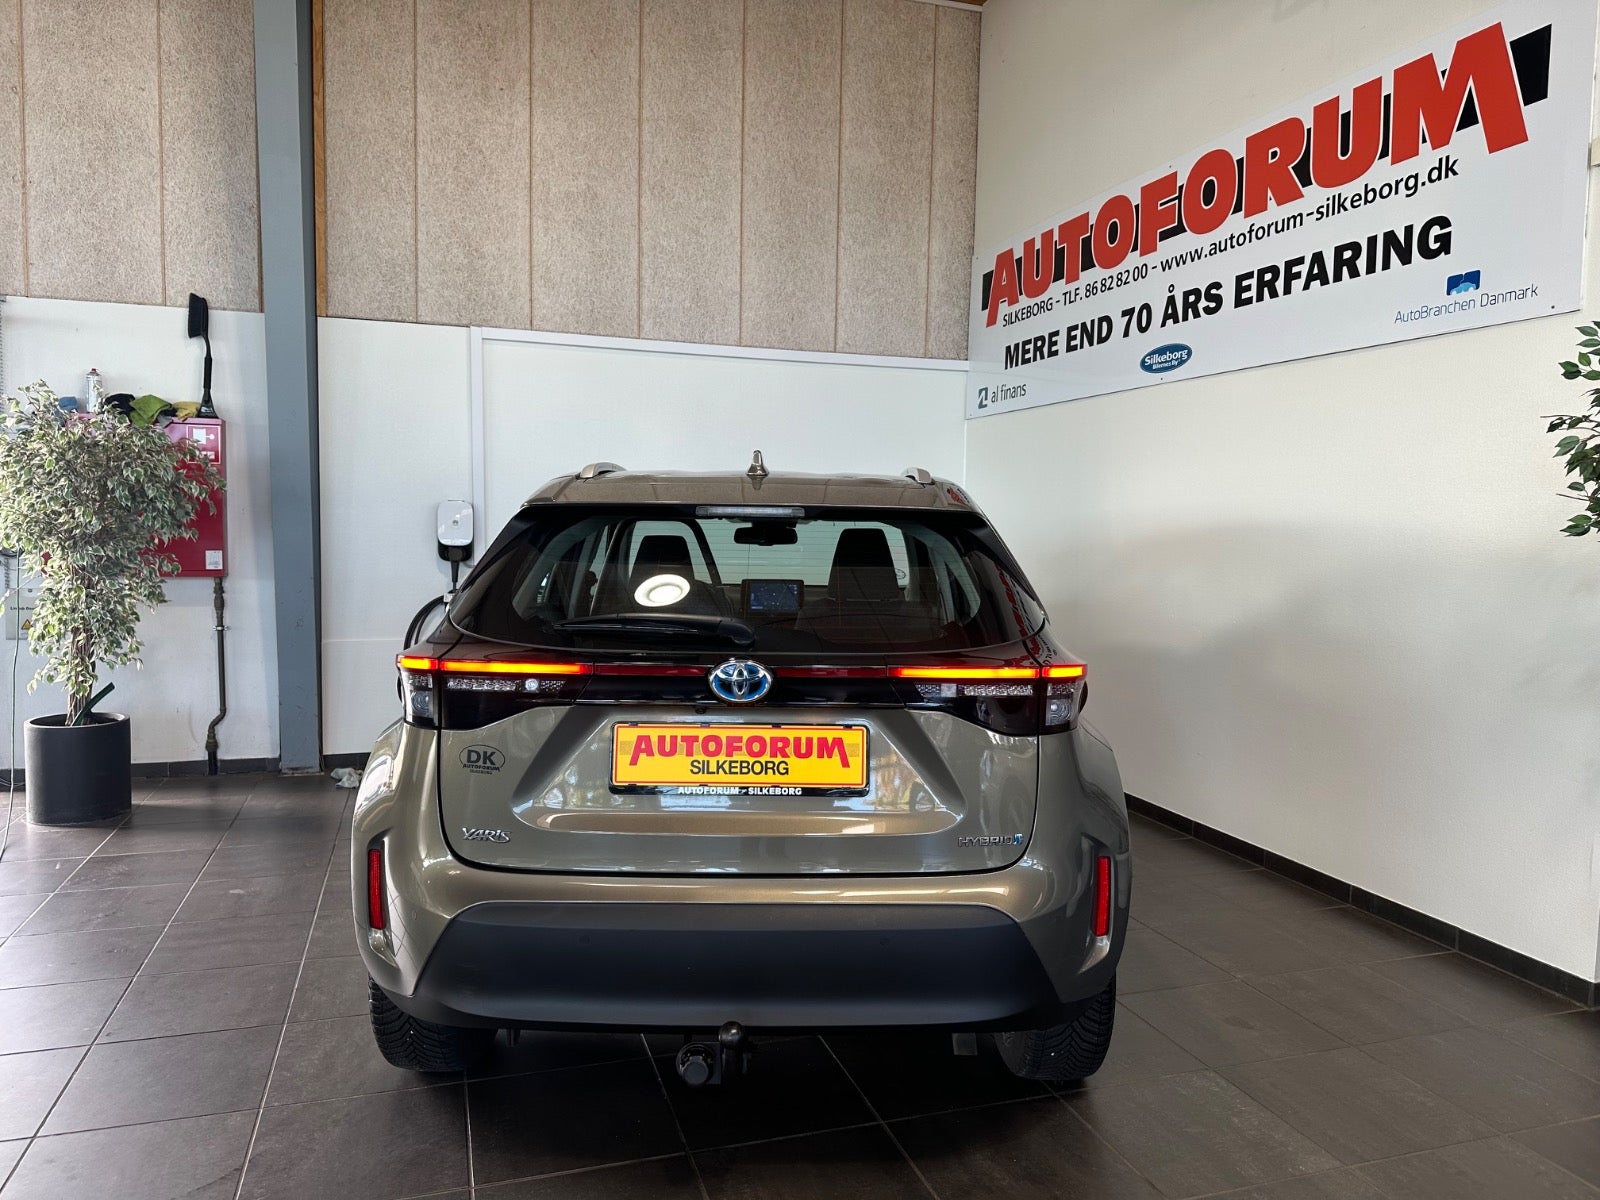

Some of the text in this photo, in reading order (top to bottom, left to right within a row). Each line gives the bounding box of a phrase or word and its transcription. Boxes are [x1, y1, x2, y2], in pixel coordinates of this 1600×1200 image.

[985, 21, 1529, 328] AUTOFORUM
[1002, 298, 1053, 327] SILKEBORG
[1062, 287, 1083, 307] TLF.
[1084, 280, 1098, 298] 86
[1099, 275, 1114, 293] 82
[1115, 269, 1131, 288] 82
[1132, 263, 1148, 282] 00
[1160, 154, 1459, 272] www.autoforum-silkeborg.dk
[1004, 215, 1453, 370] MERE END 70 ÅRS ERFARING
[1394, 283, 1539, 324] AutoBranchen Danmark
[1144, 349, 1189, 366] Silkeborg
[990, 383, 1027, 403] al finans
[466, 749, 496, 766] DK
[629, 734, 850, 768] AUTOFORUM
[690, 759, 789, 775] SILKEBORG
[677, 786, 739, 795] AUTOFORUM
[748, 786, 802, 796] SILKEBORG
[957, 836, 1014, 848] HYBRID
